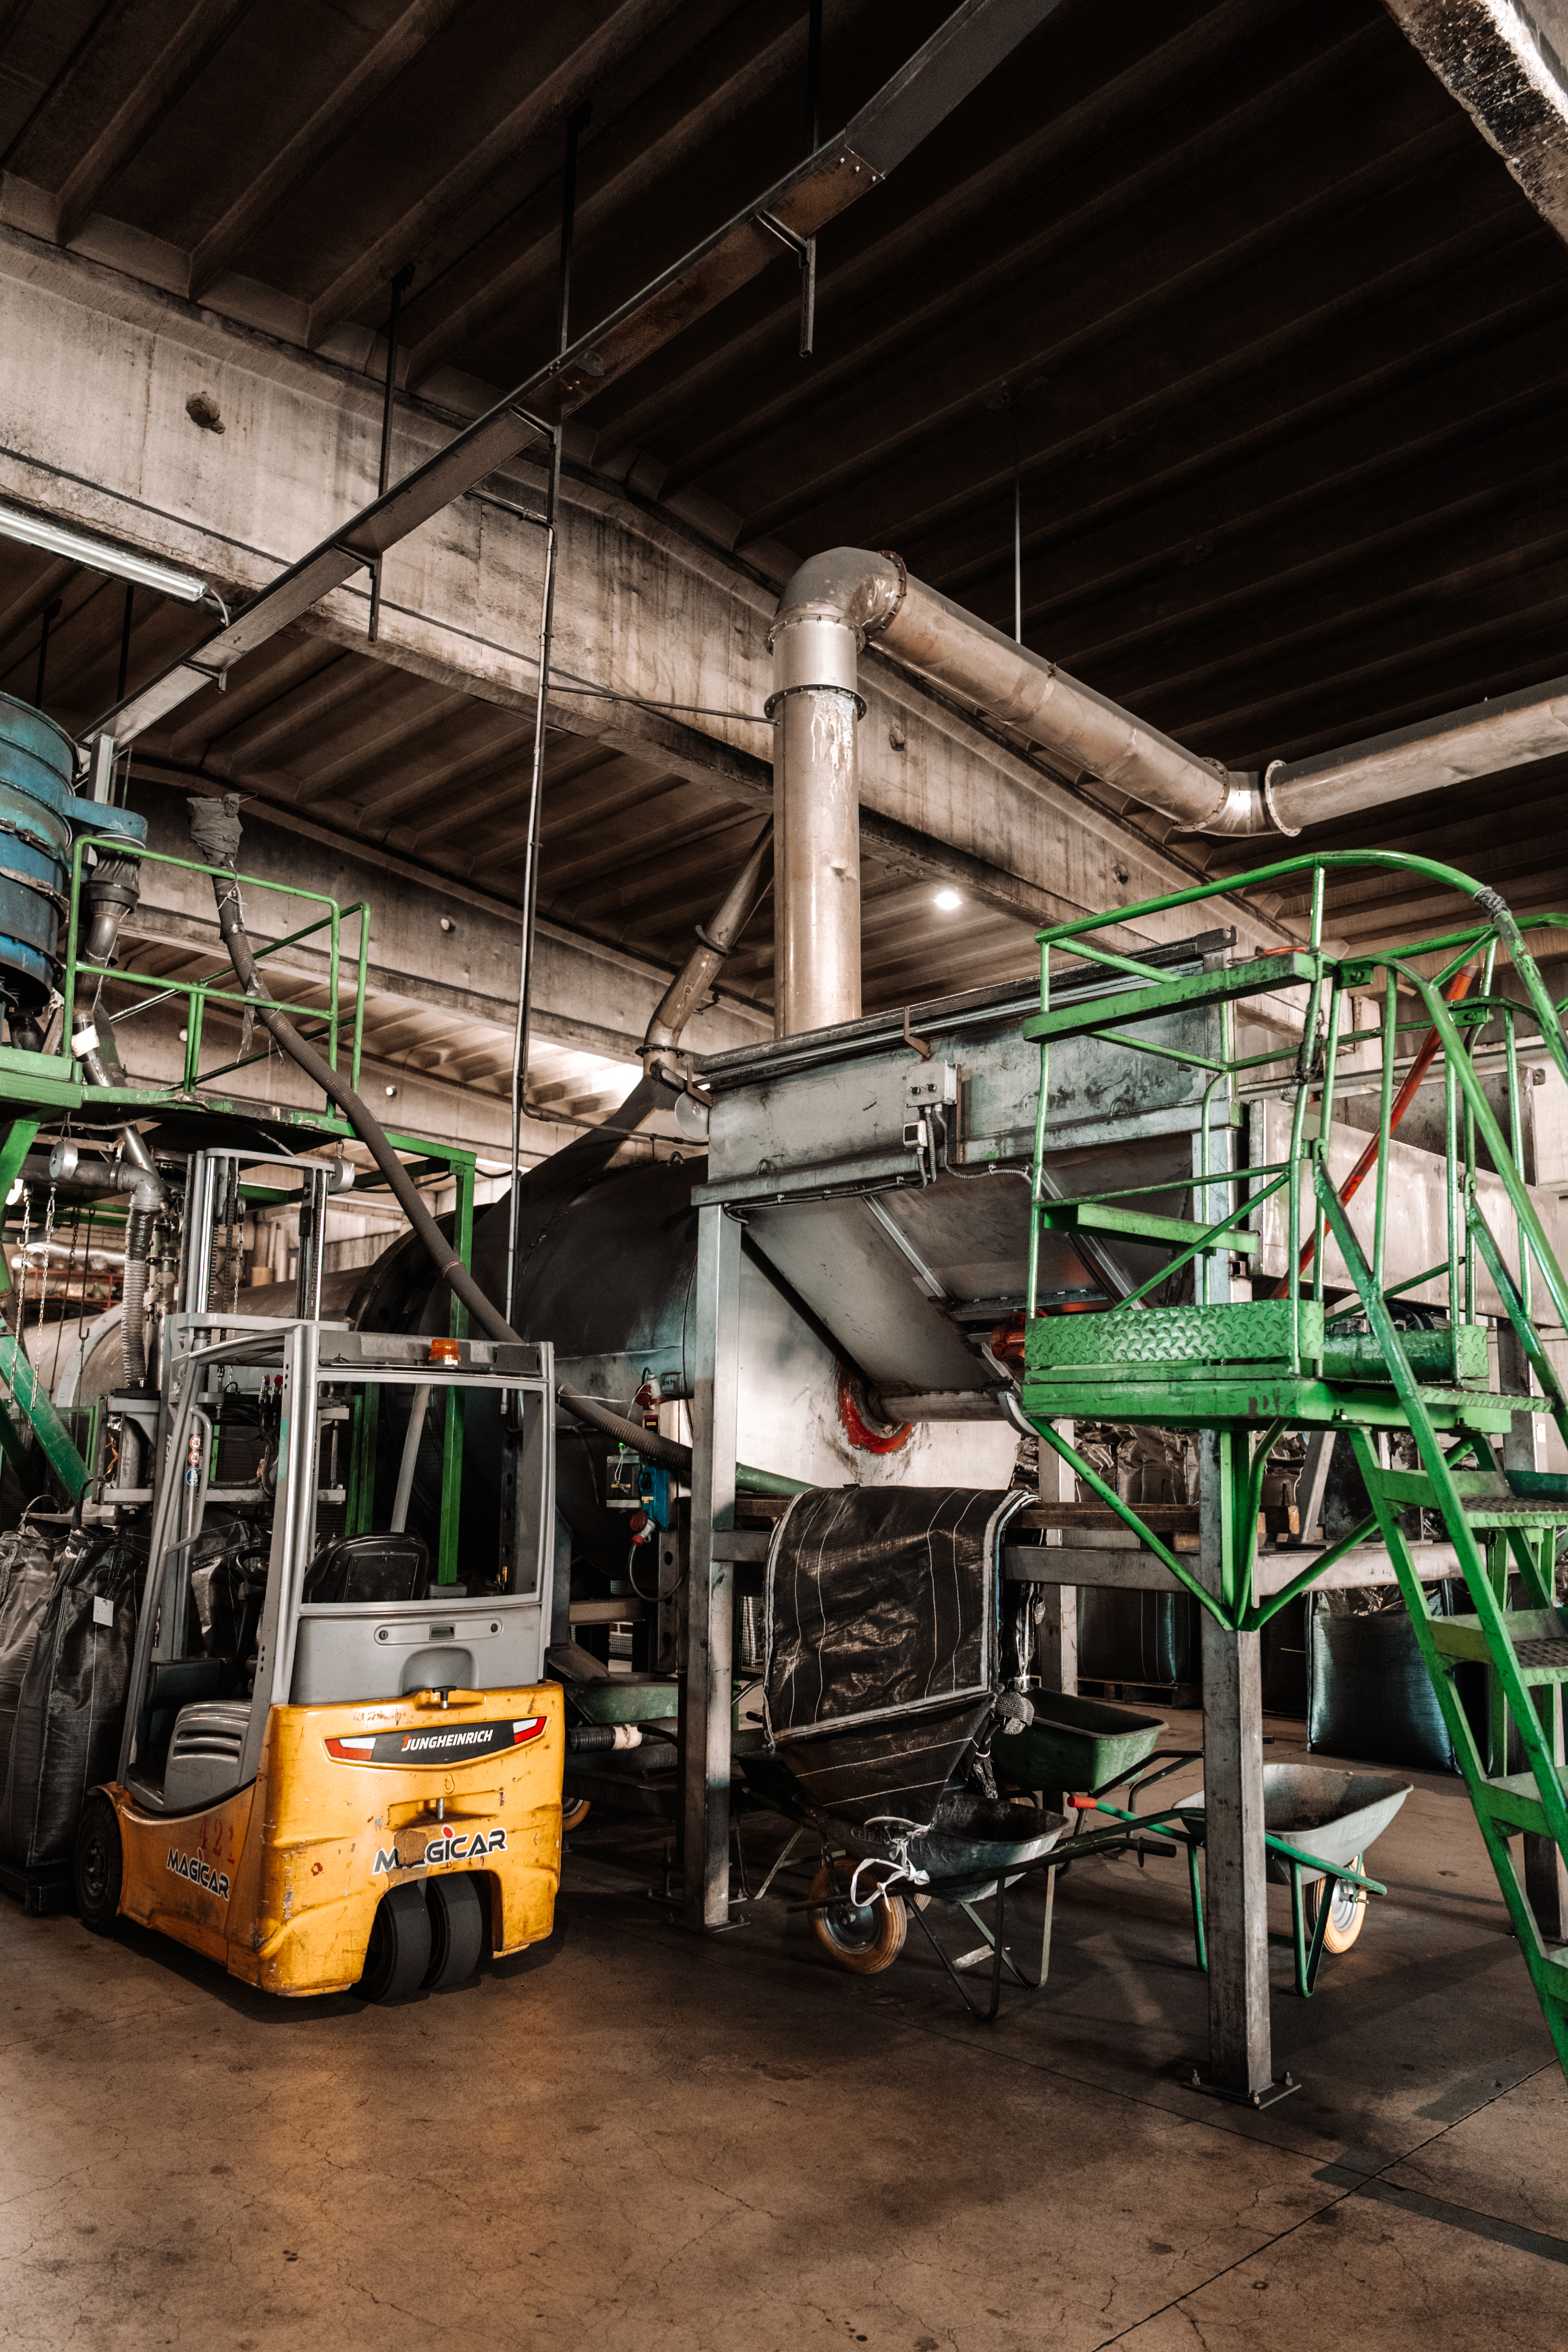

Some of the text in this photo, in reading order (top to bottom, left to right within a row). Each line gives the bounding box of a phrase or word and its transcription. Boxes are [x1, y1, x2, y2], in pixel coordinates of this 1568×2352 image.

[401, 1729, 494, 1752] JUNGHEINRICH
[167, 1847, 230, 1901] MAGICAR
[372, 1825, 508, 1874] MGICAR
